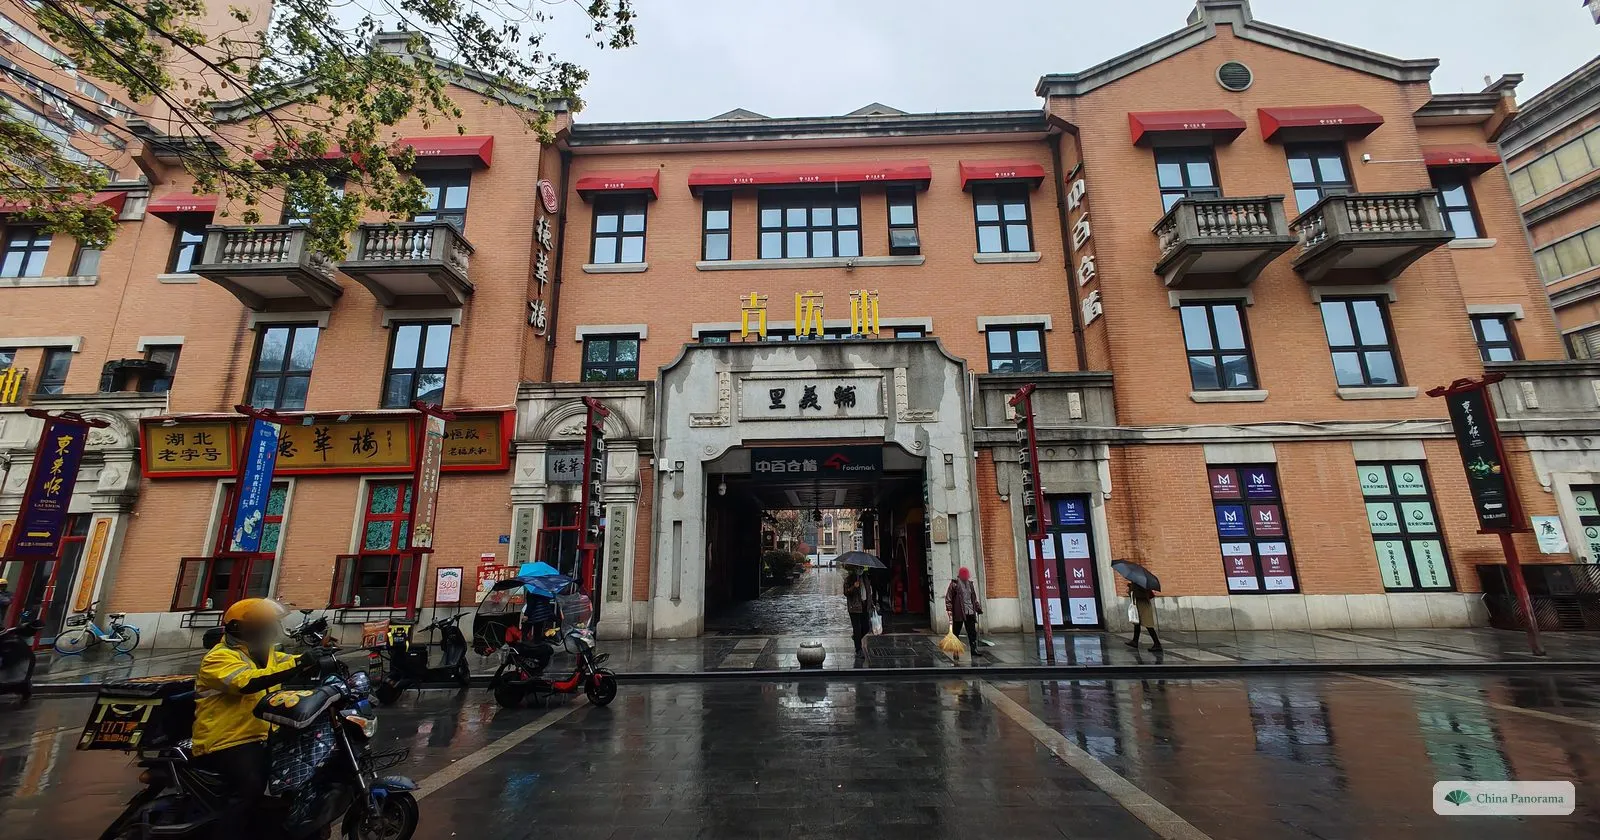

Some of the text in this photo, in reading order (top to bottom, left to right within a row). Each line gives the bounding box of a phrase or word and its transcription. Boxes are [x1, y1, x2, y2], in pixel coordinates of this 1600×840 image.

[1067, 178, 1102, 326] 中百仓储
[165, 433, 212, 447] 湖北
[158, 447, 222, 462] 老字号
[755, 459, 818, 473] 中百仓储
[842, 463, 876, 471] Foodmart
[1016, 428, 1035, 505] 中百仓储
[591, 438, 605, 517] 中百仓储
